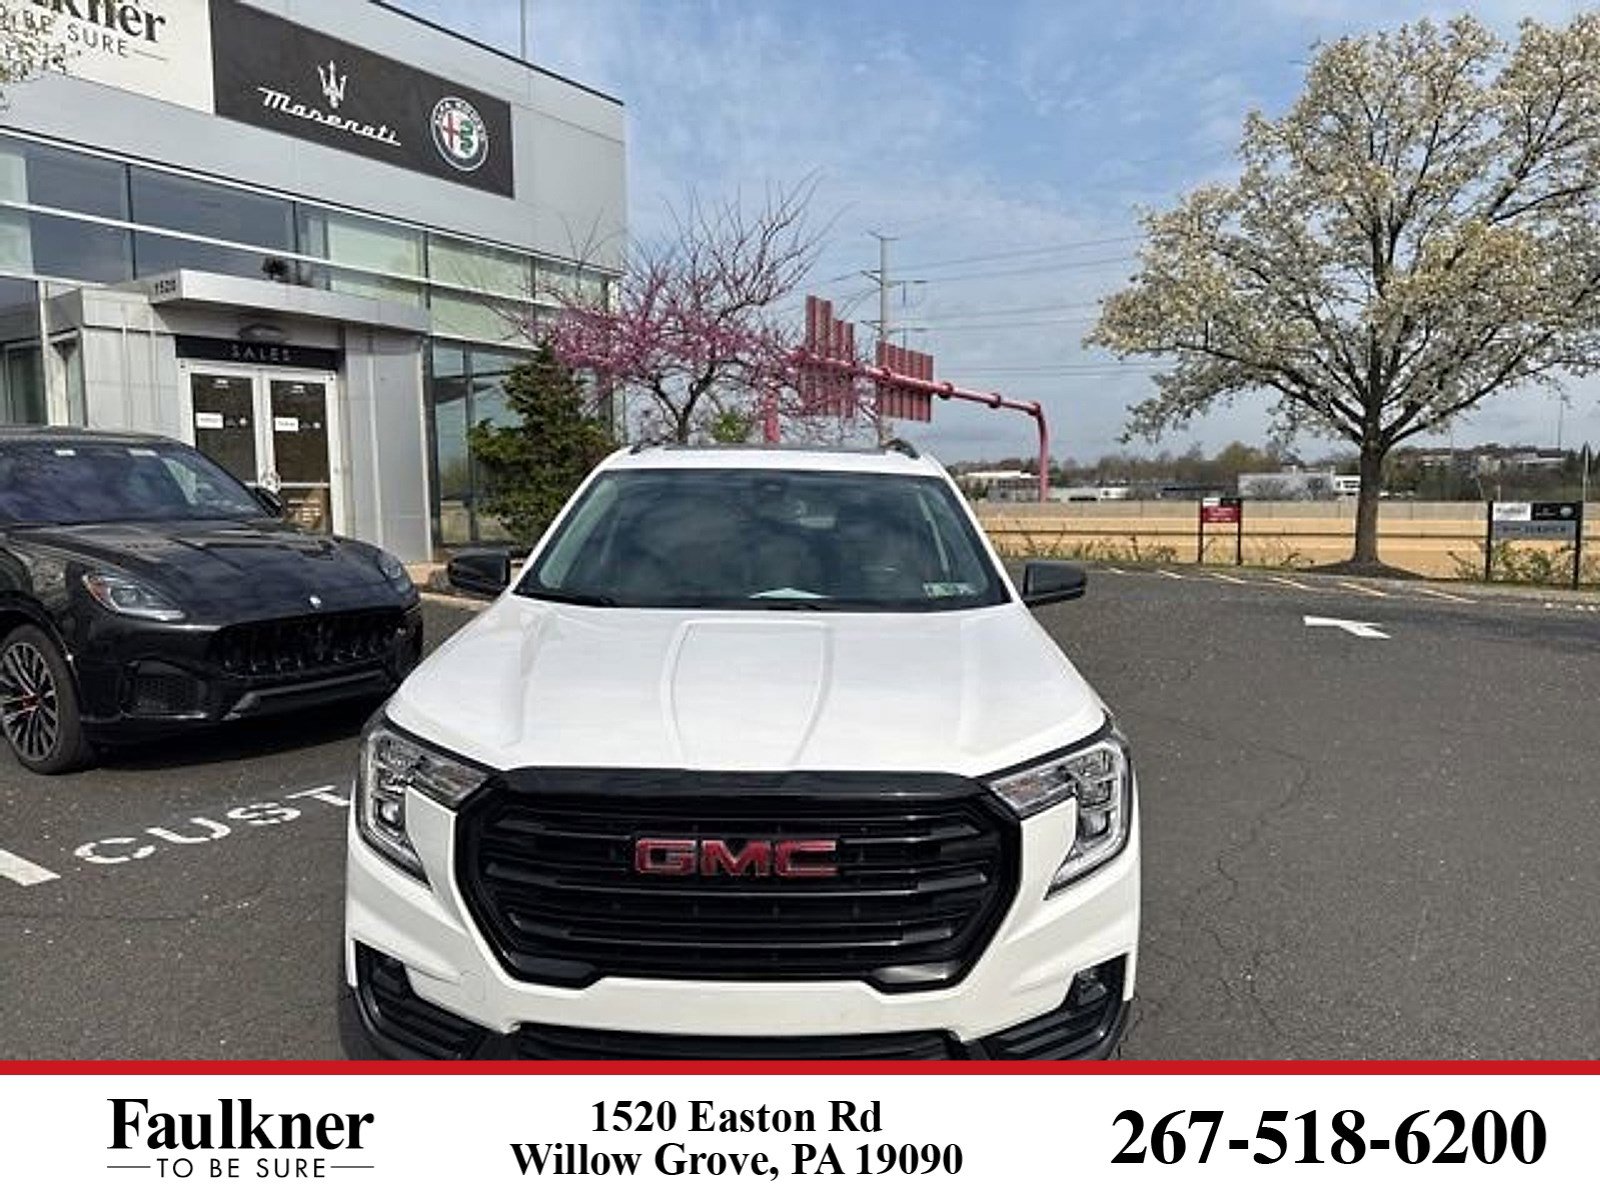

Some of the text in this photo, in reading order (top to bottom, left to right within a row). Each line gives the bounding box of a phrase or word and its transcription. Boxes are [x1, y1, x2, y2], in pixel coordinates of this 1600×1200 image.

[66, 22, 129, 58] SURE
[257, 86, 402, 146] Maserati
[635, 839, 839, 877] GMC
